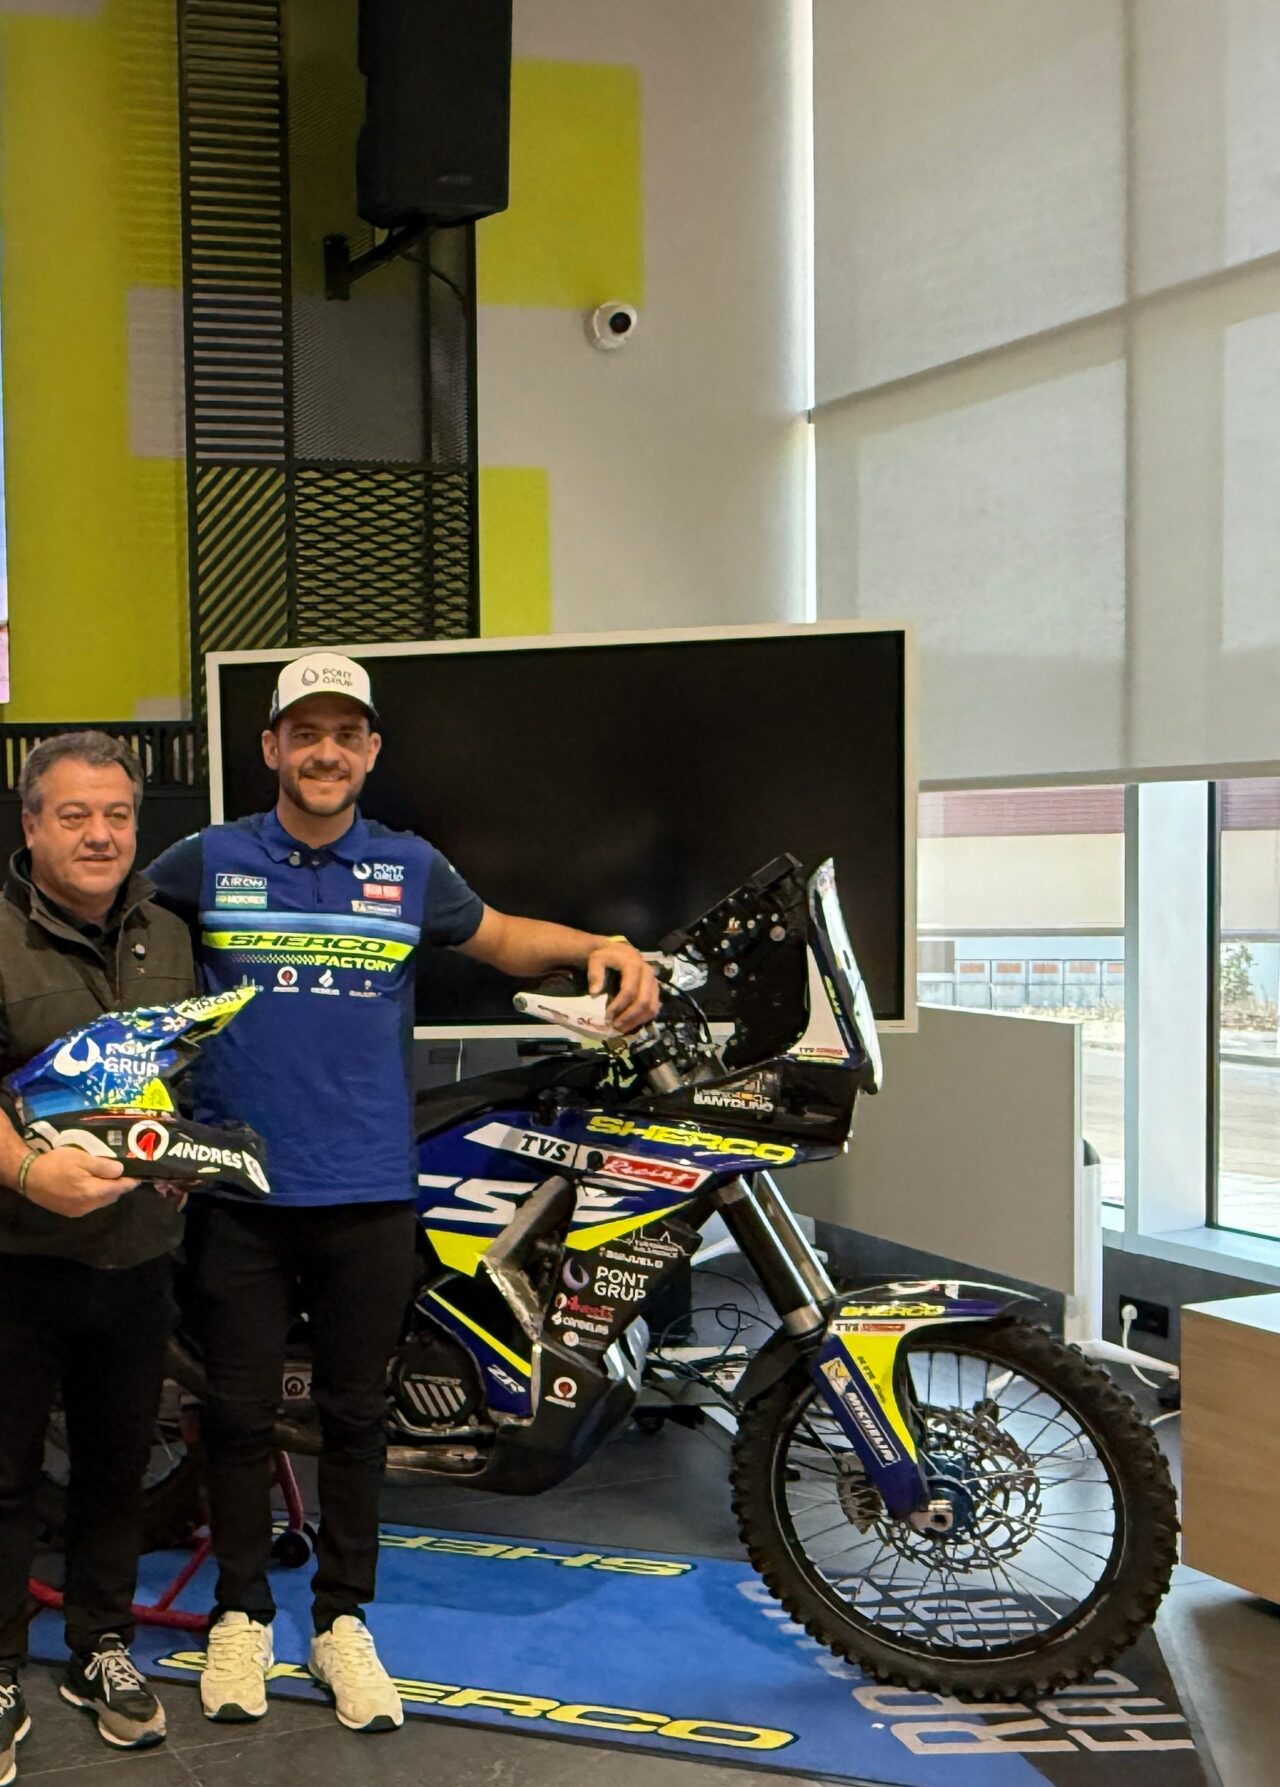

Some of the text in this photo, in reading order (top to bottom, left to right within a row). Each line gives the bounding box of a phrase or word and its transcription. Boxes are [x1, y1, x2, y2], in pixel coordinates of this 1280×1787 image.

[228, 935, 387, 953] SHERCO
[314, 955, 396, 973] FACTORY
[104, 1057, 160, 1077] GRUP
[520, 1134, 570, 1162] TVS
[586, 1115, 796, 1165] SHERCO
[603, 1159, 697, 1187] Racing
[596, 1265, 649, 1288] PONT
[594, 1281, 647, 1303] GRUP
